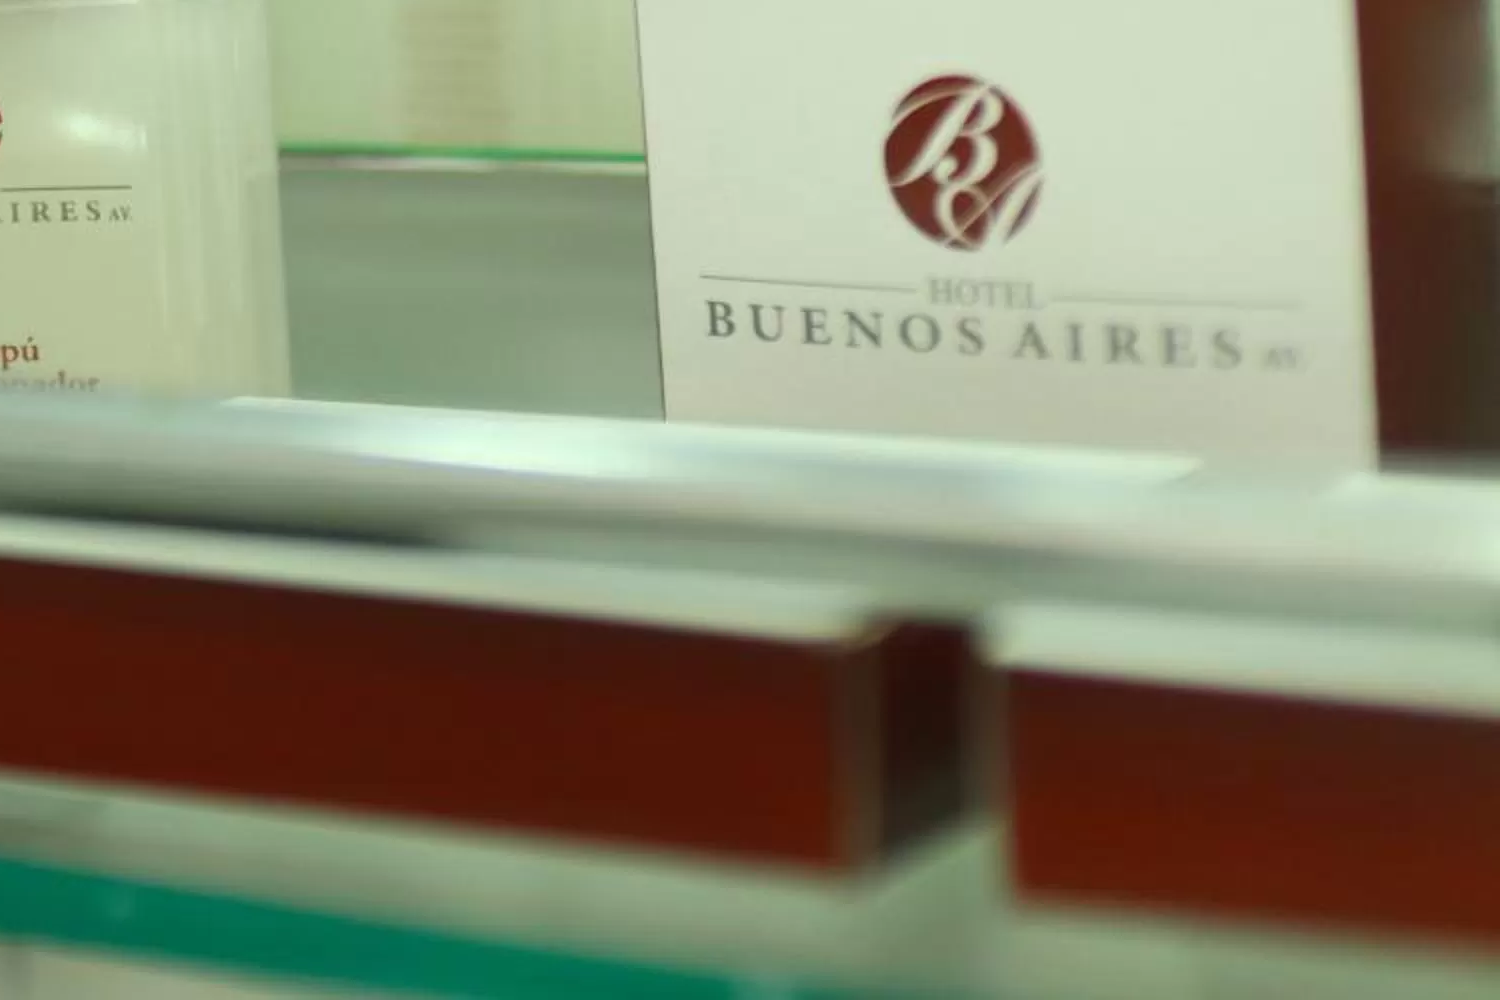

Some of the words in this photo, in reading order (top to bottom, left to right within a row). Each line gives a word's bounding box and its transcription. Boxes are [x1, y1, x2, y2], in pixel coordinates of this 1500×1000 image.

[926, 276, 1040, 312] HOTEL
[705, 299, 986, 358] BUENOS
[1009, 320, 1244, 370] AIRES
